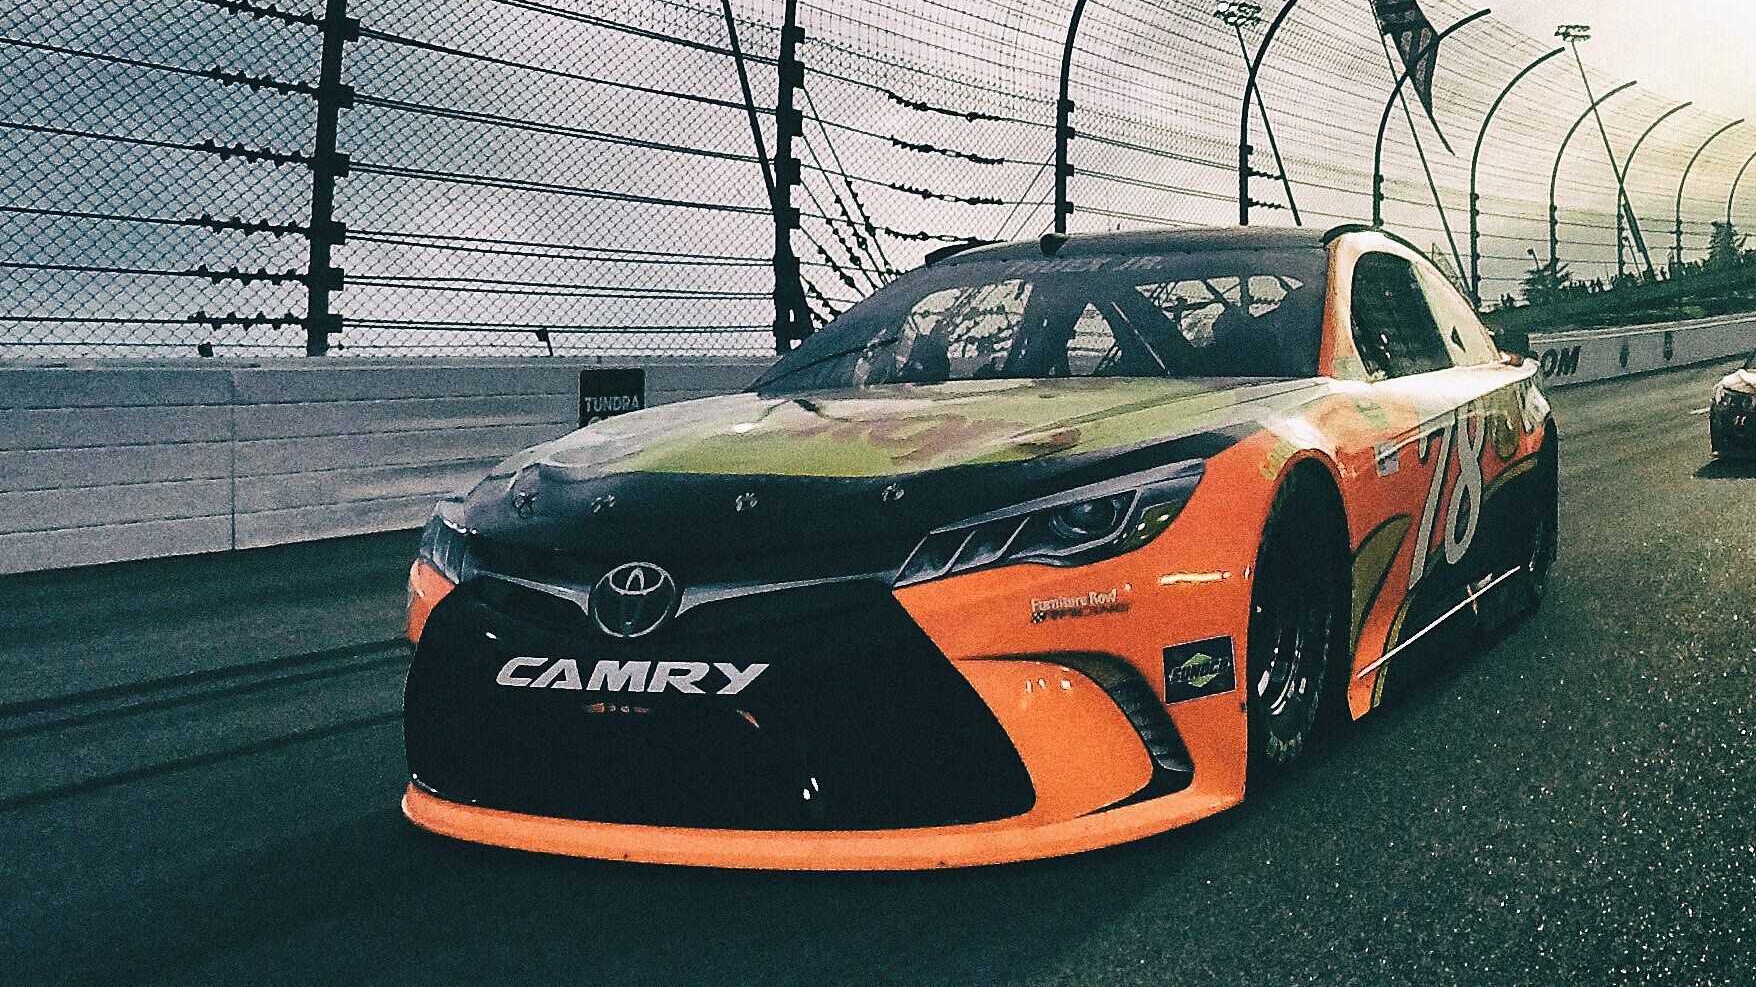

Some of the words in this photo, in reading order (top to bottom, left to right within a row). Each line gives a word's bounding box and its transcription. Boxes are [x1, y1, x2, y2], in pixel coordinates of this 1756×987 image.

[1540, 345, 1583, 379] OM
[584, 394, 640, 413] TUNDRA
[1408, 399, 1487, 590] 78
[496, 655, 770, 696] CAMRY
